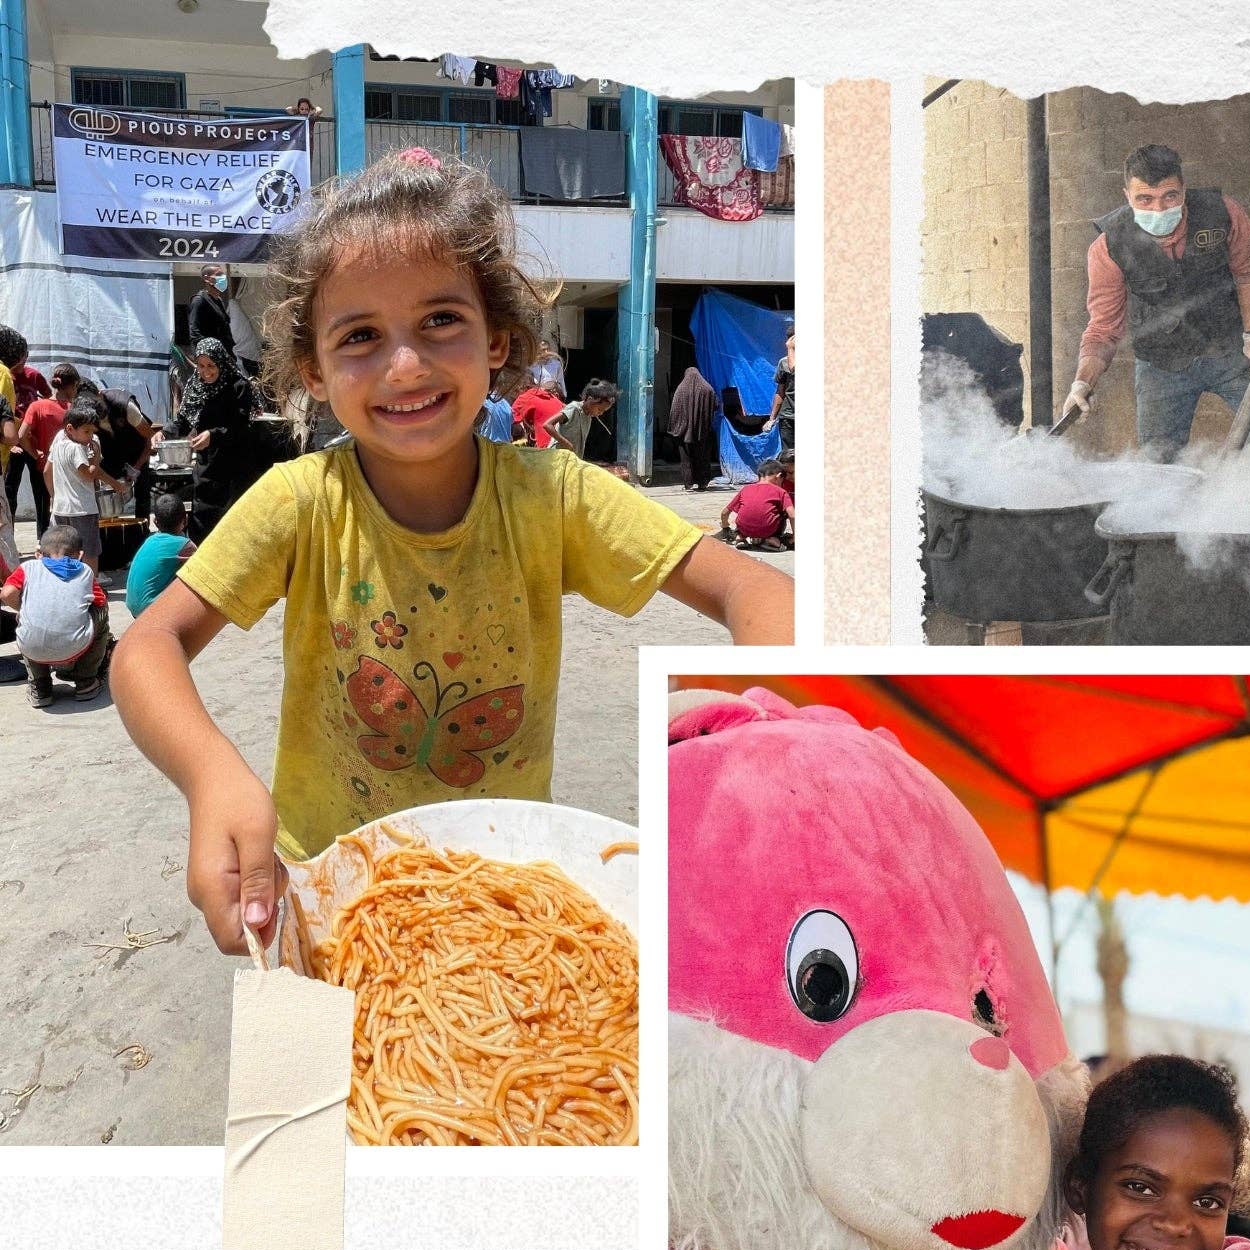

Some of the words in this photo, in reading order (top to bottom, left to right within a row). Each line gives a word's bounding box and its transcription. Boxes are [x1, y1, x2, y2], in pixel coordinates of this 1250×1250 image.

[128, 120, 187, 137] PIOUS
[194, 124, 292, 141] PROJECTS
[84, 143, 211, 167] EMERGENCY
[217, 152, 281, 168] RELIEF
[134, 173, 173, 189] FOR
[180, 176, 235, 192] GAZA
[96, 208, 158, 225] WEAR
[163, 211, 203, 228] THE
[209, 214, 272, 230] PEACE
[158, 237, 220, 259] 2024
